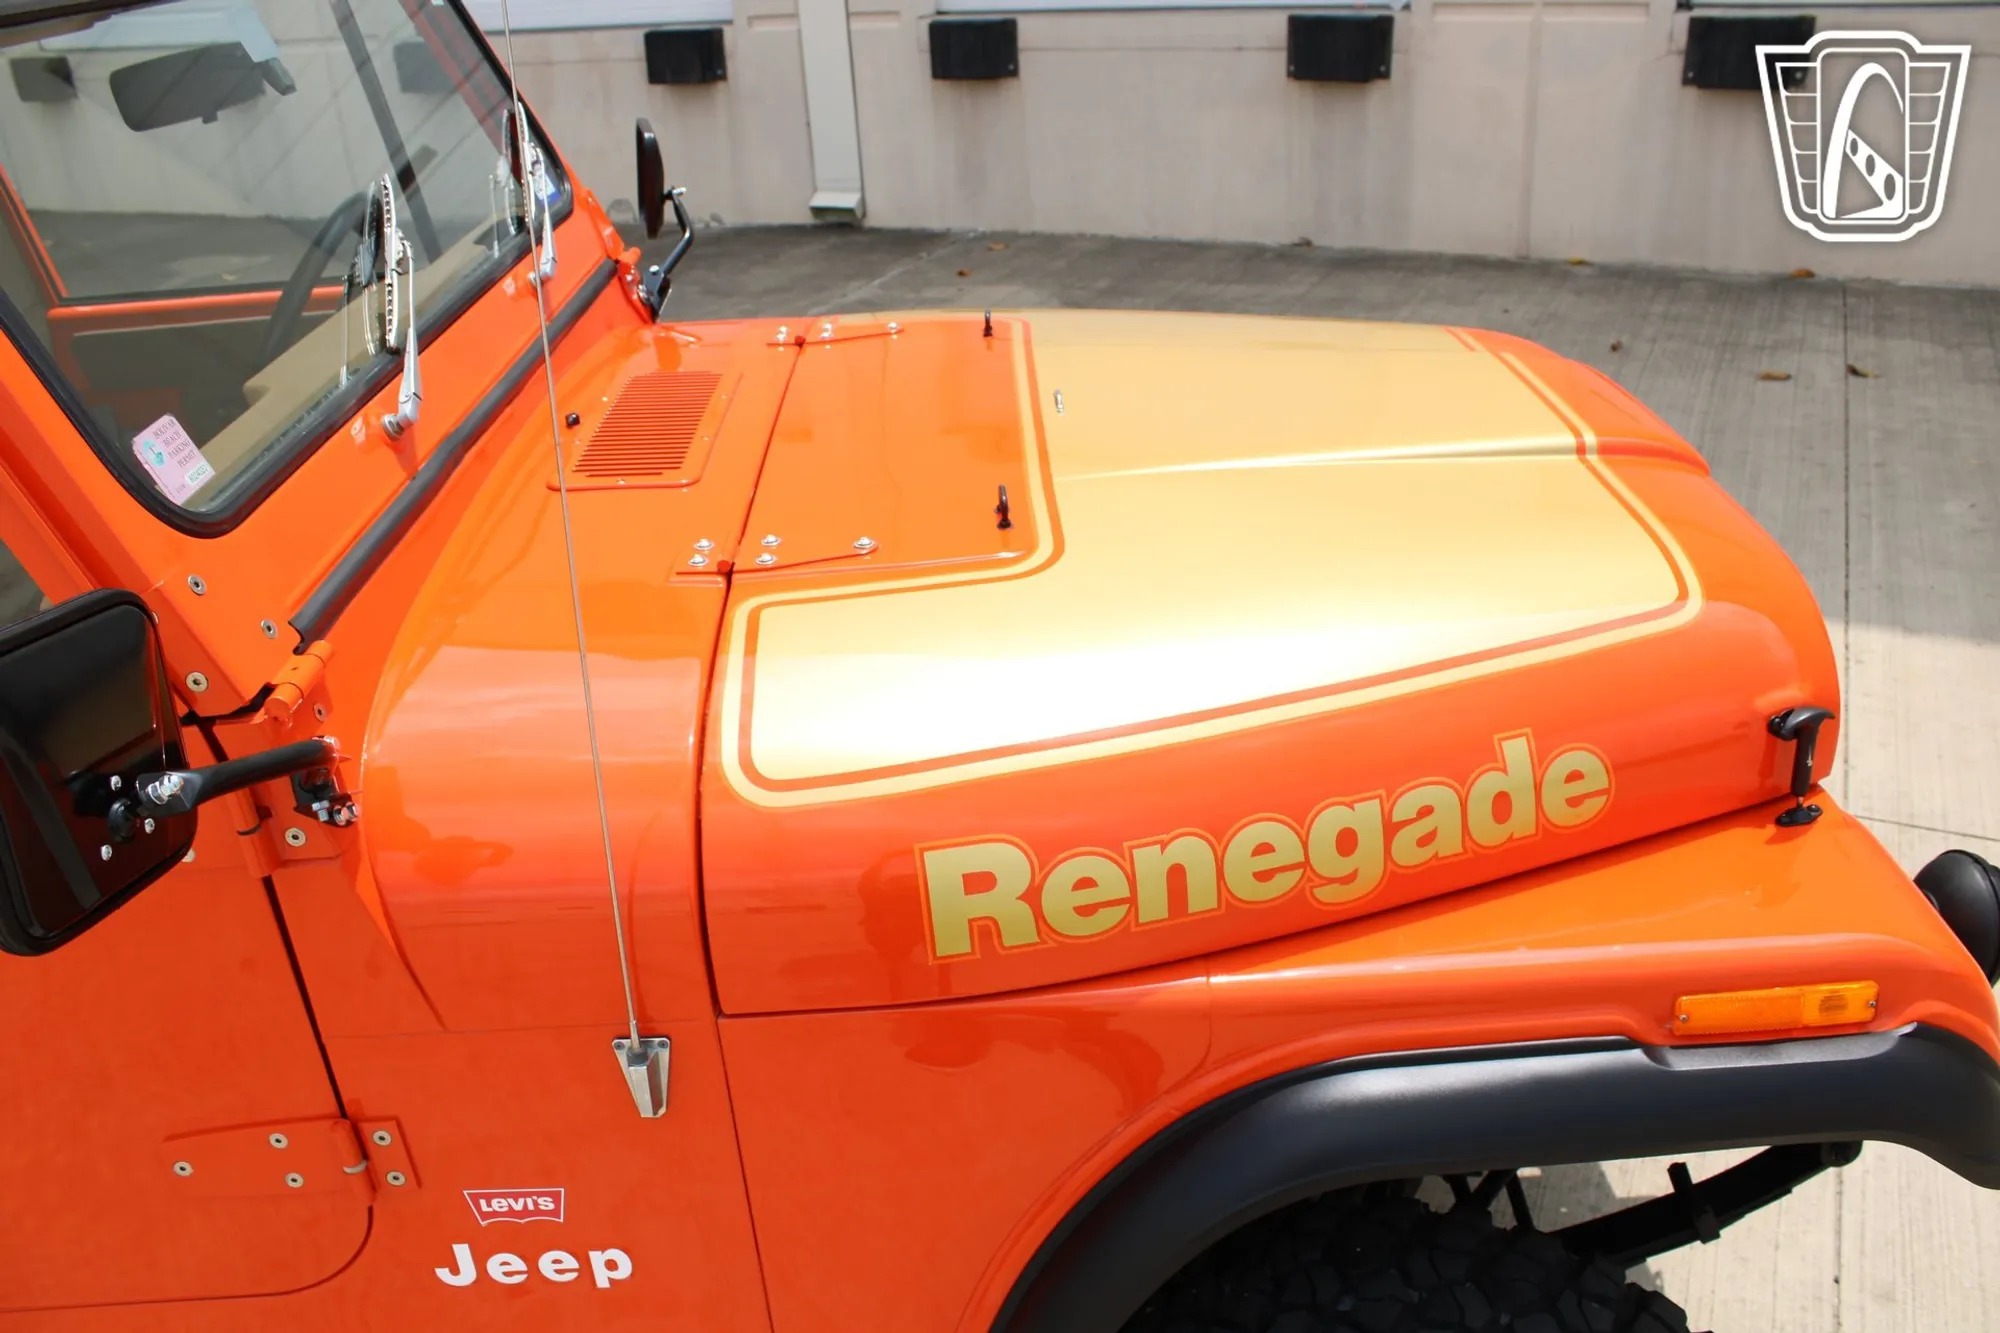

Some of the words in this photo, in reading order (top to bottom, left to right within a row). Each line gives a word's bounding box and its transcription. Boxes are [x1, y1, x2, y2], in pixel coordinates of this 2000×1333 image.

[168, 440, 191, 458] PARKING
[177, 450, 197, 468] PERMIT
[918, 732, 1612, 961] Renegade
[434, 1243, 633, 1289] Jeep
